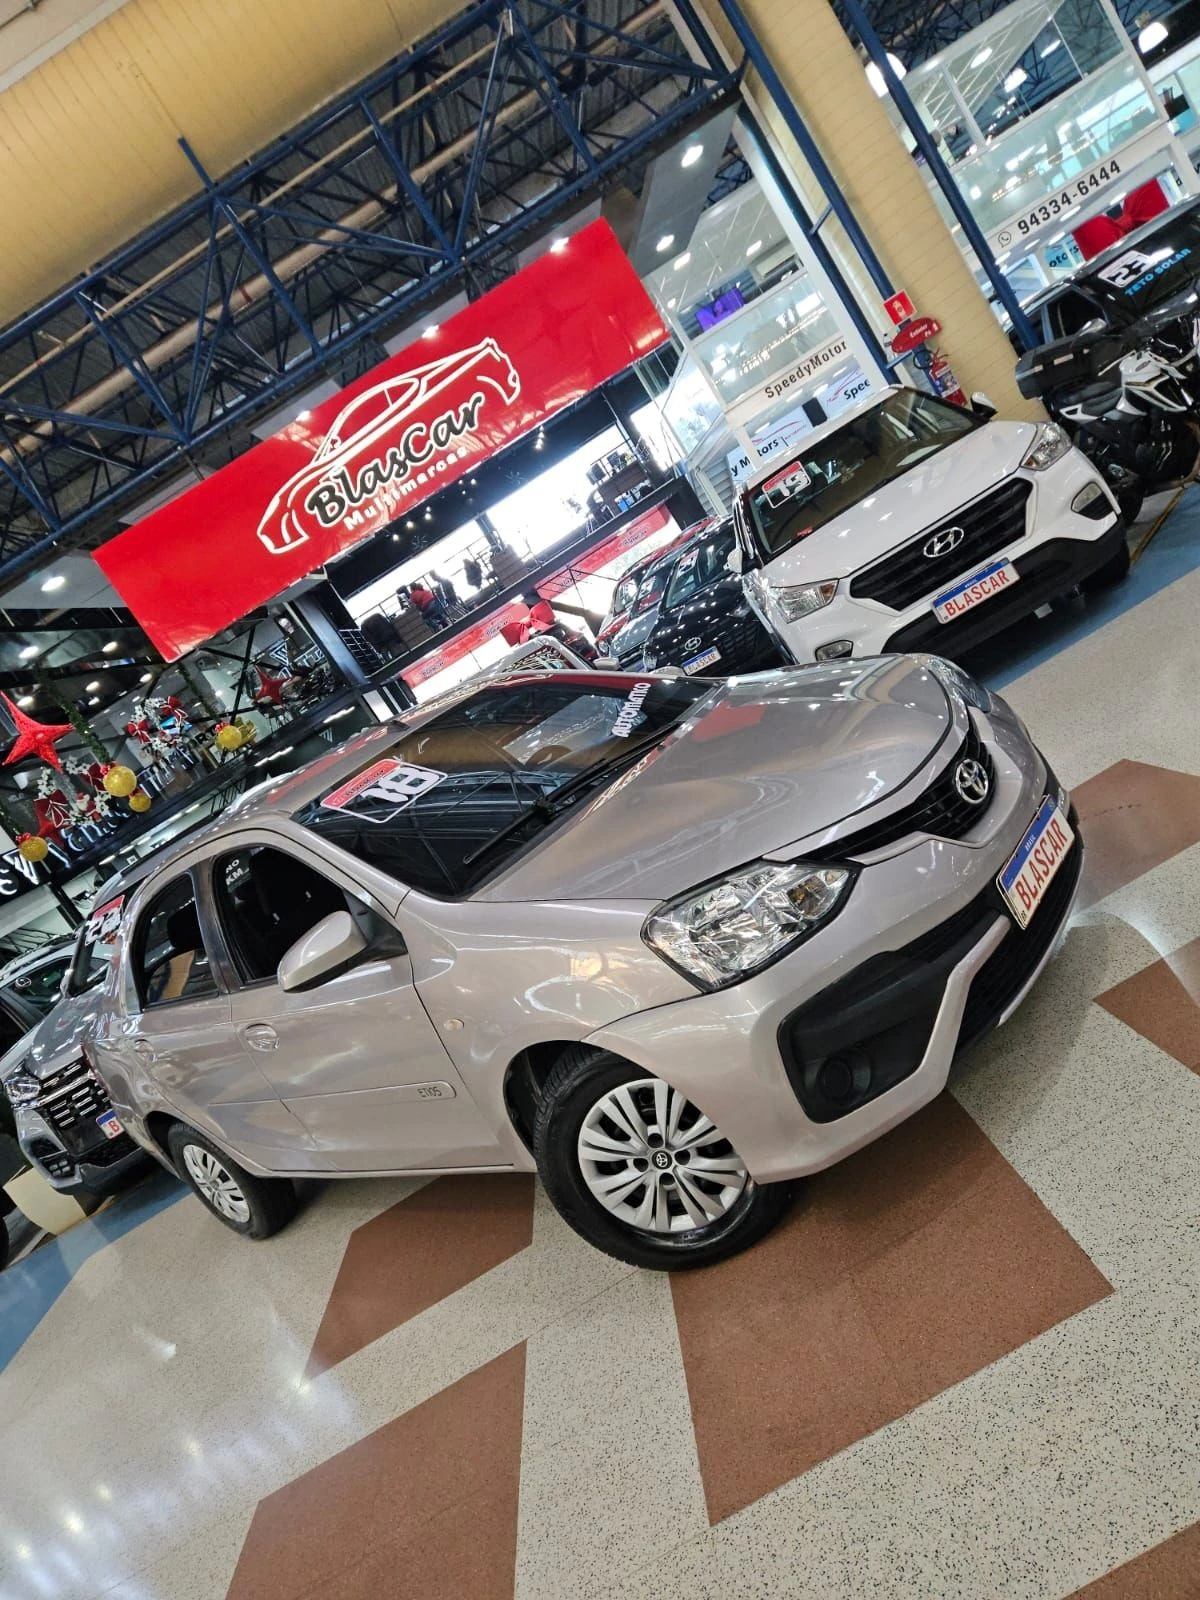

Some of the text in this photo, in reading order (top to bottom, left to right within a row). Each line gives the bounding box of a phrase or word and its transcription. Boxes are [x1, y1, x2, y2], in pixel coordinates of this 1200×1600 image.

[1017, 159, 1121, 235] 94334-6444
[1106, 256, 1149, 286] 23
[1125, 248, 1192, 296] TETO SOLAR
[765, 340, 847, 399] SpeedyMotor
[307, 393, 484, 526] BlasCar
[343, 446, 468, 530] Multimarcas
[944, 570, 1009, 616] BLASCAR
[361, 767, 440, 802] 18
[1015, 818, 1067, 910] BLASCAR
